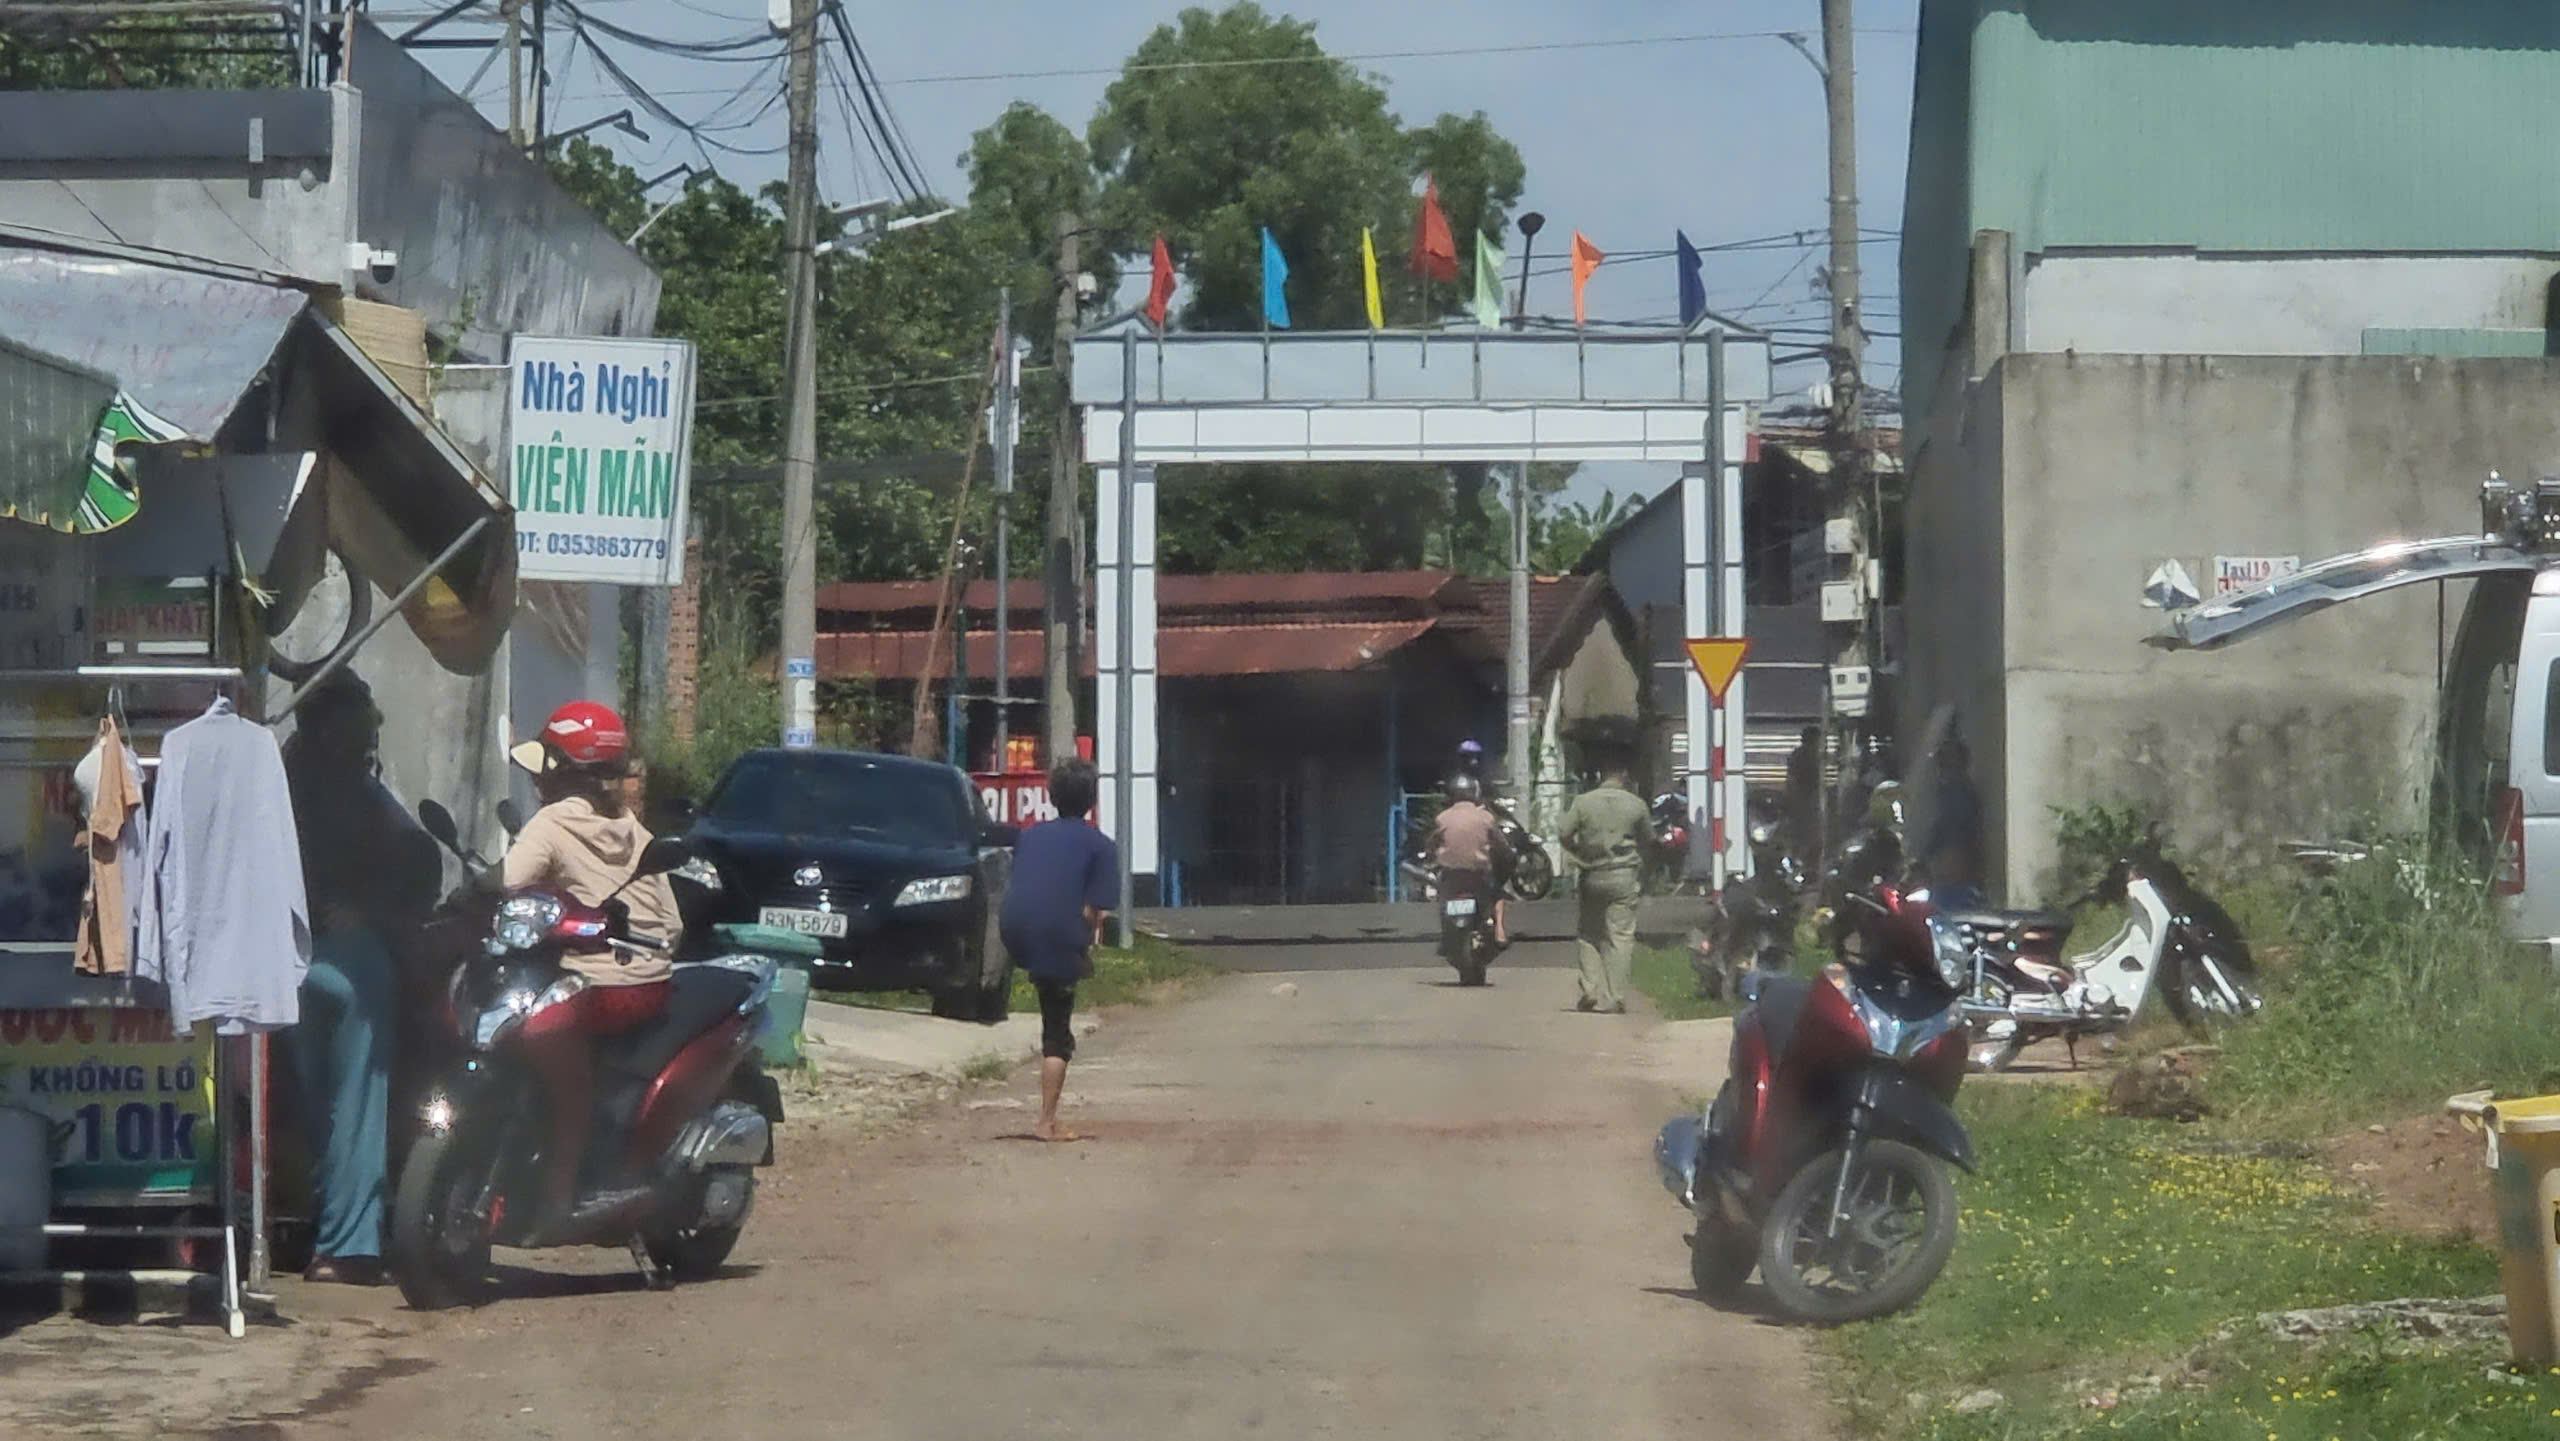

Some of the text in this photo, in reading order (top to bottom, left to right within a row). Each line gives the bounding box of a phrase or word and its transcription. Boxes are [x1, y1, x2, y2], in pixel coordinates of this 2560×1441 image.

[522, 359, 671, 425] Nhà Nghỉ
[517, 429, 673, 519] VIÊN MÃN
[77, 1102, 198, 1161] 10k
